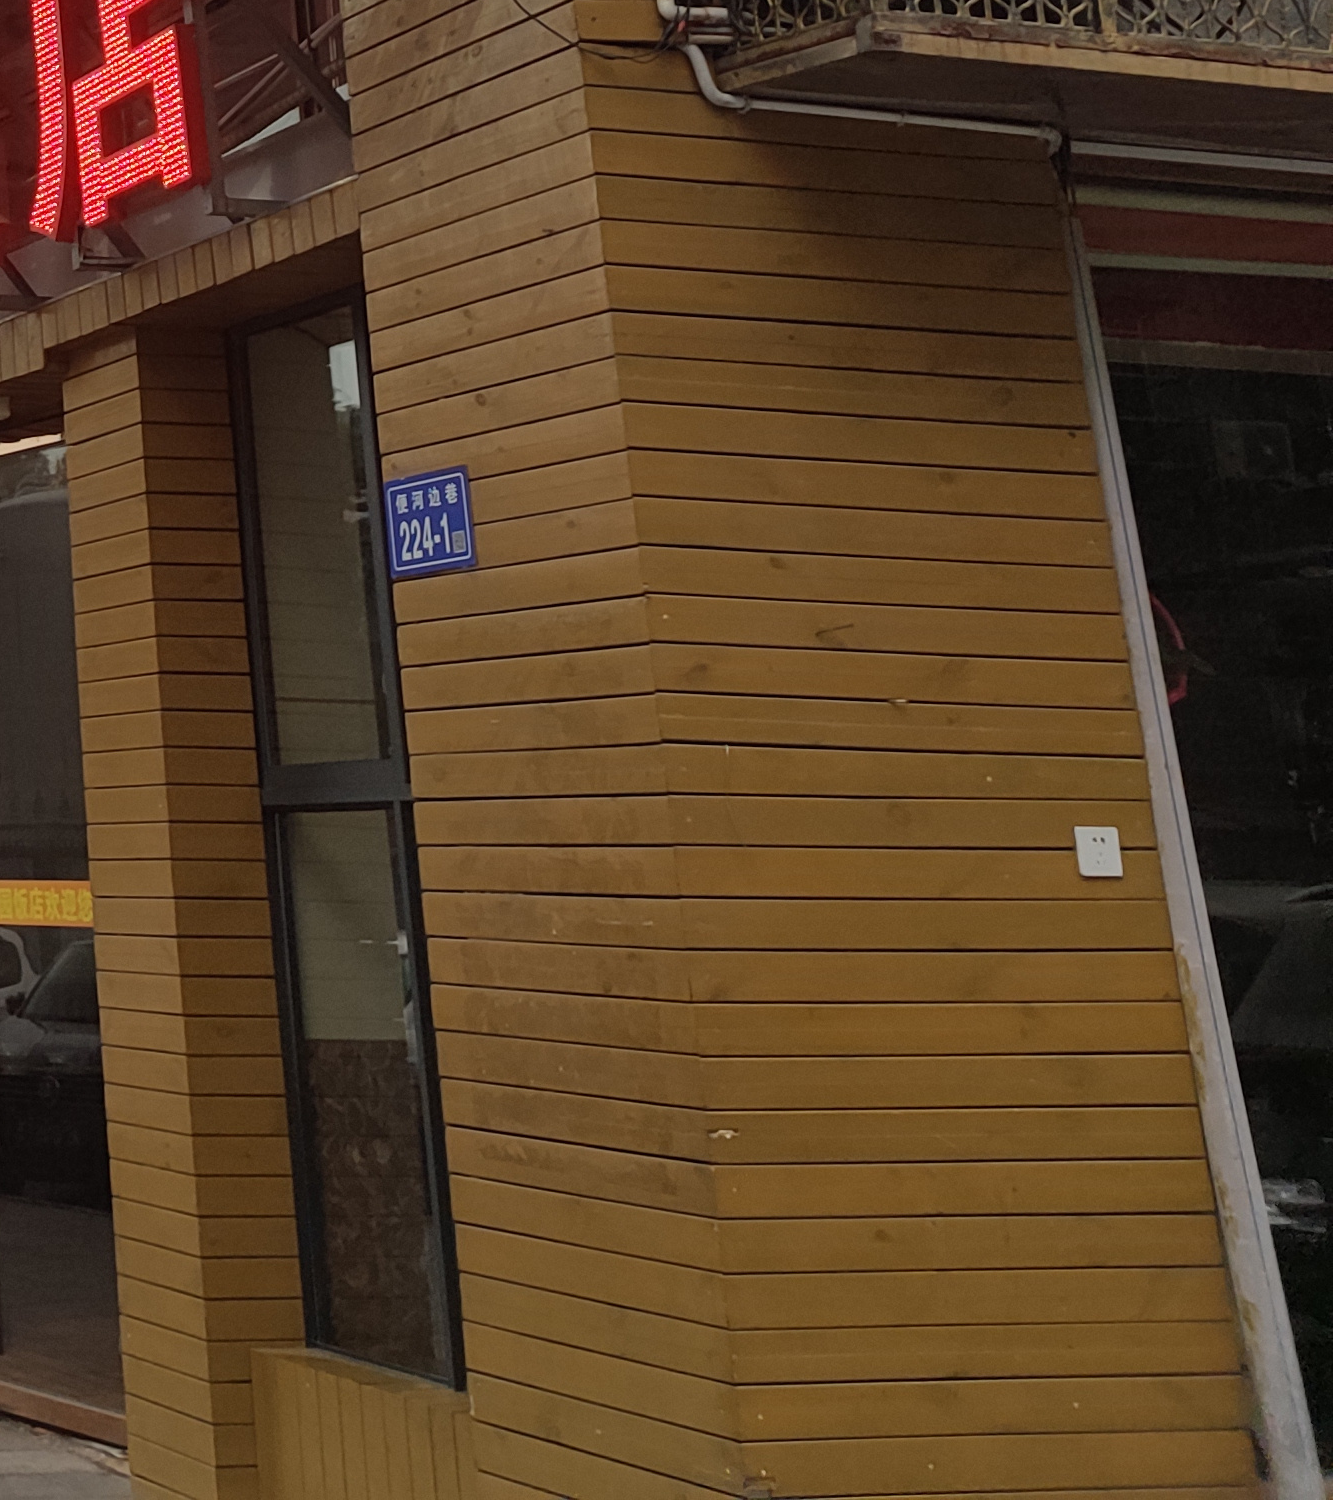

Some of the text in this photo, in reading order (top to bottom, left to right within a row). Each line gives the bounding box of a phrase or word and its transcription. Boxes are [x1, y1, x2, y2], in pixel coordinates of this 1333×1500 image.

[395, 482, 459, 515] 便河边巷
[399, 511, 451, 562] 224-1
